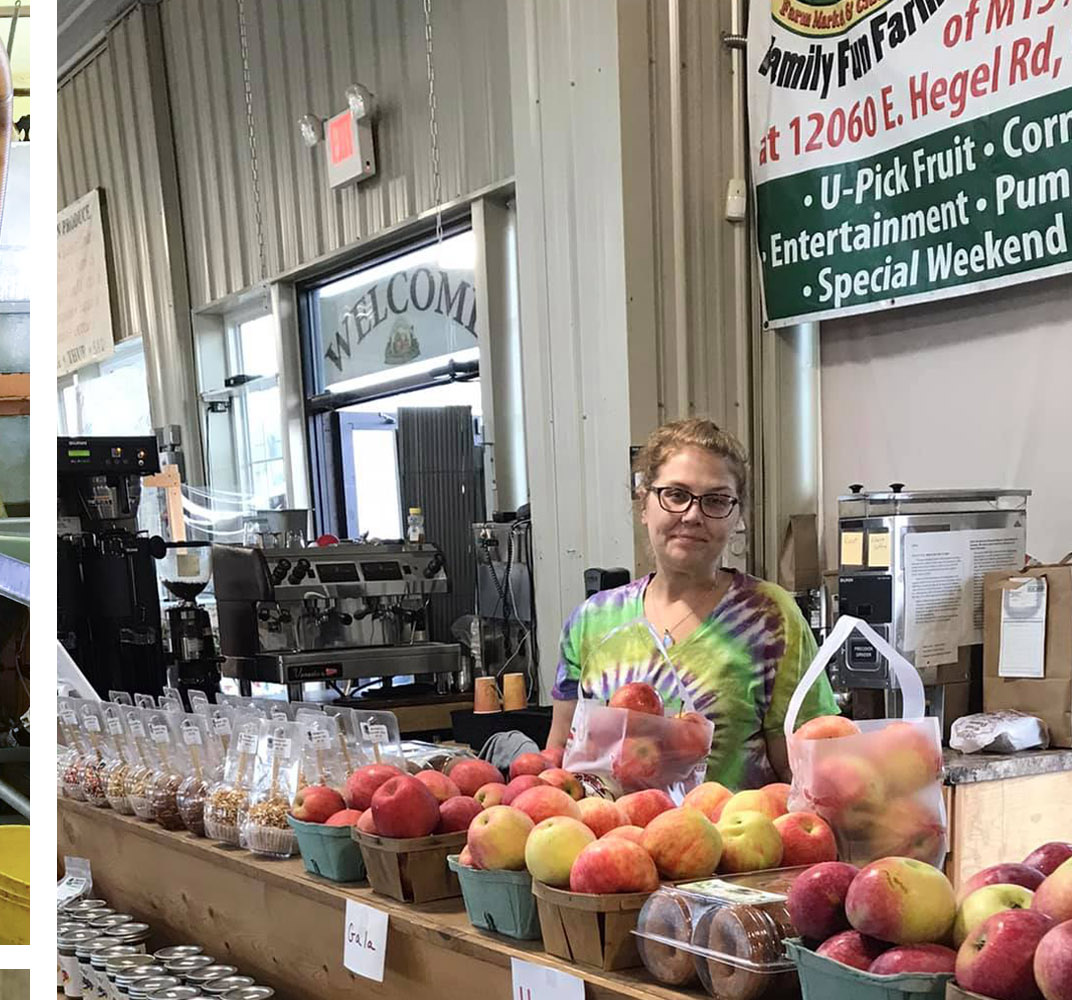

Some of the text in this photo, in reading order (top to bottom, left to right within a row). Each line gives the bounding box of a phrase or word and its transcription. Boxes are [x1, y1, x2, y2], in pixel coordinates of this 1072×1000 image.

[837, 34, 872, 88] Fun
[943, 0, 979, 48] of
[789, 95, 876, 156] 12060
[881, 85, 903, 131] E.
[909, 46, 1002, 120] Hegel
[1009, 25, 1062, 85] Rd,
[820, 156, 910, 210] U-Pick
[914, 135, 976, 189] Fruit
[770, 191, 969, 268] Entertainment
[818, 213, 1067, 308] Special Weekend
[348, 922, 376, 951] Gala
